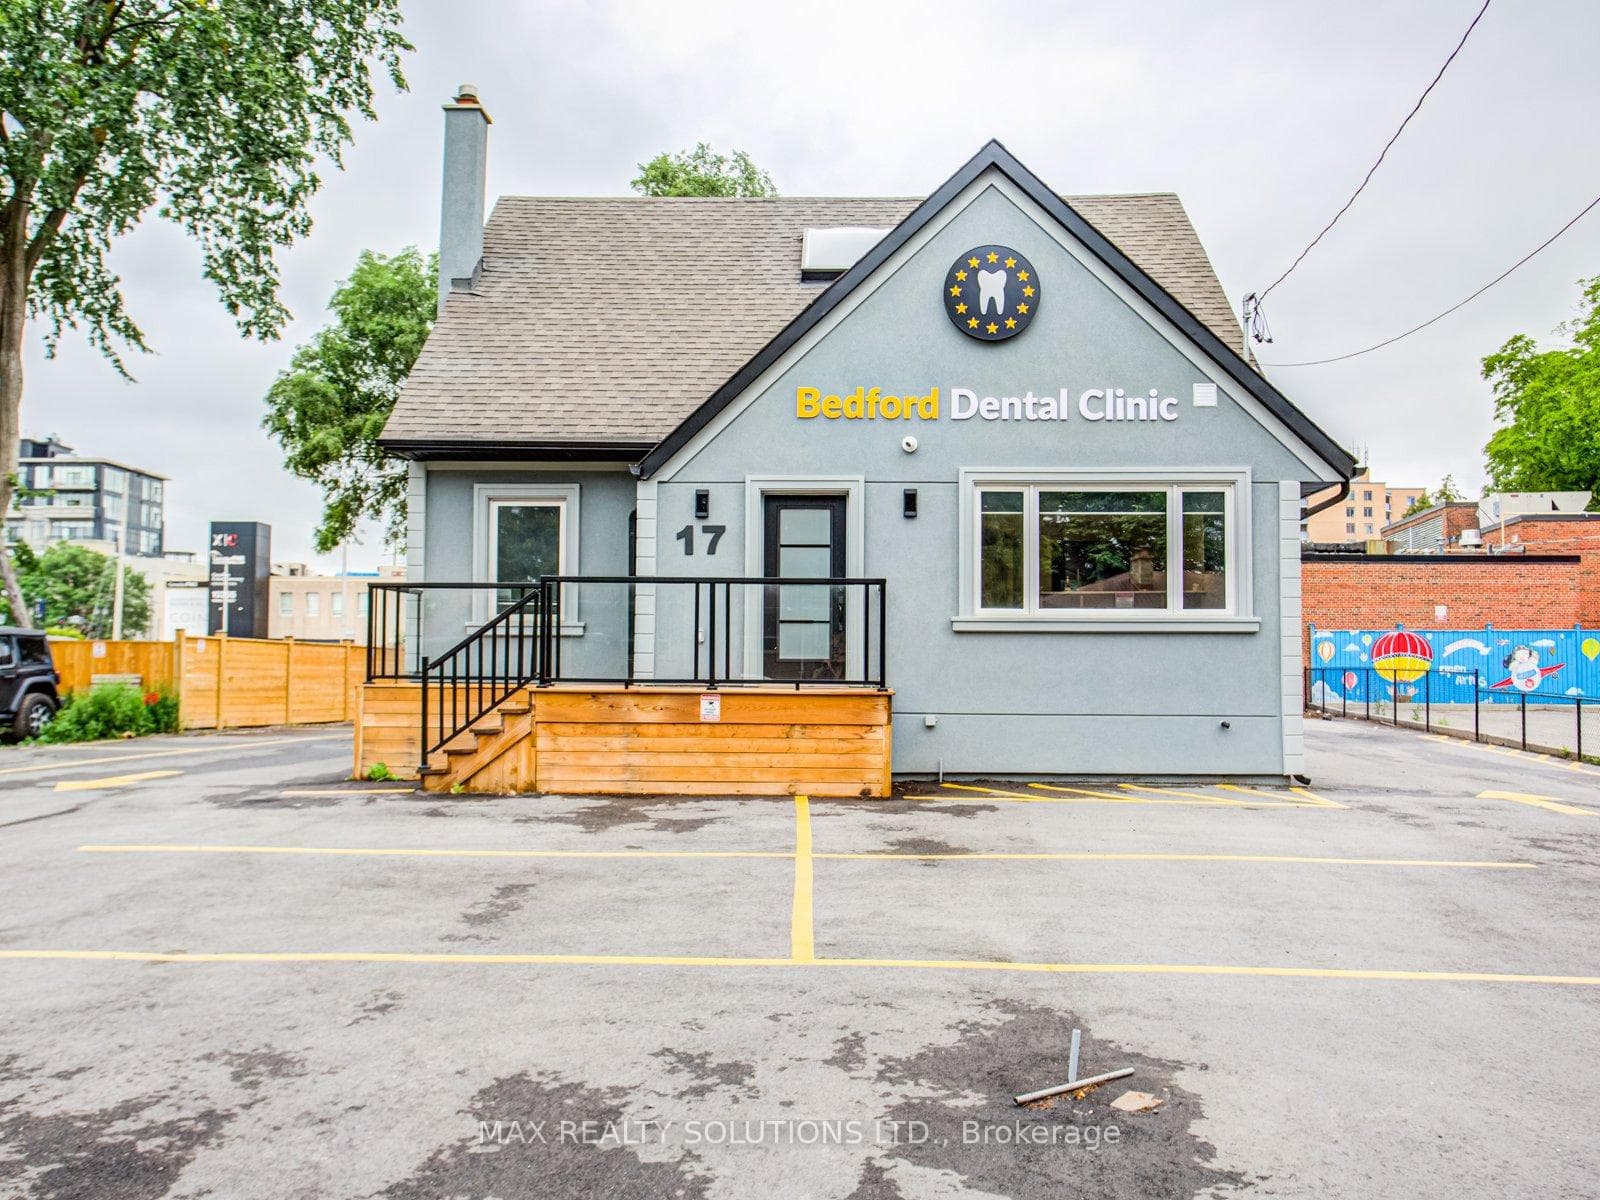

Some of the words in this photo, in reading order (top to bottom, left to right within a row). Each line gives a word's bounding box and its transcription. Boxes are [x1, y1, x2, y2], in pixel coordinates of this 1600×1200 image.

[796, 386, 939, 421] Bedford
[950, 387, 1068, 421] Dental
[1078, 387, 1179, 421] Clinic
[676, 525, 726, 556] 17
